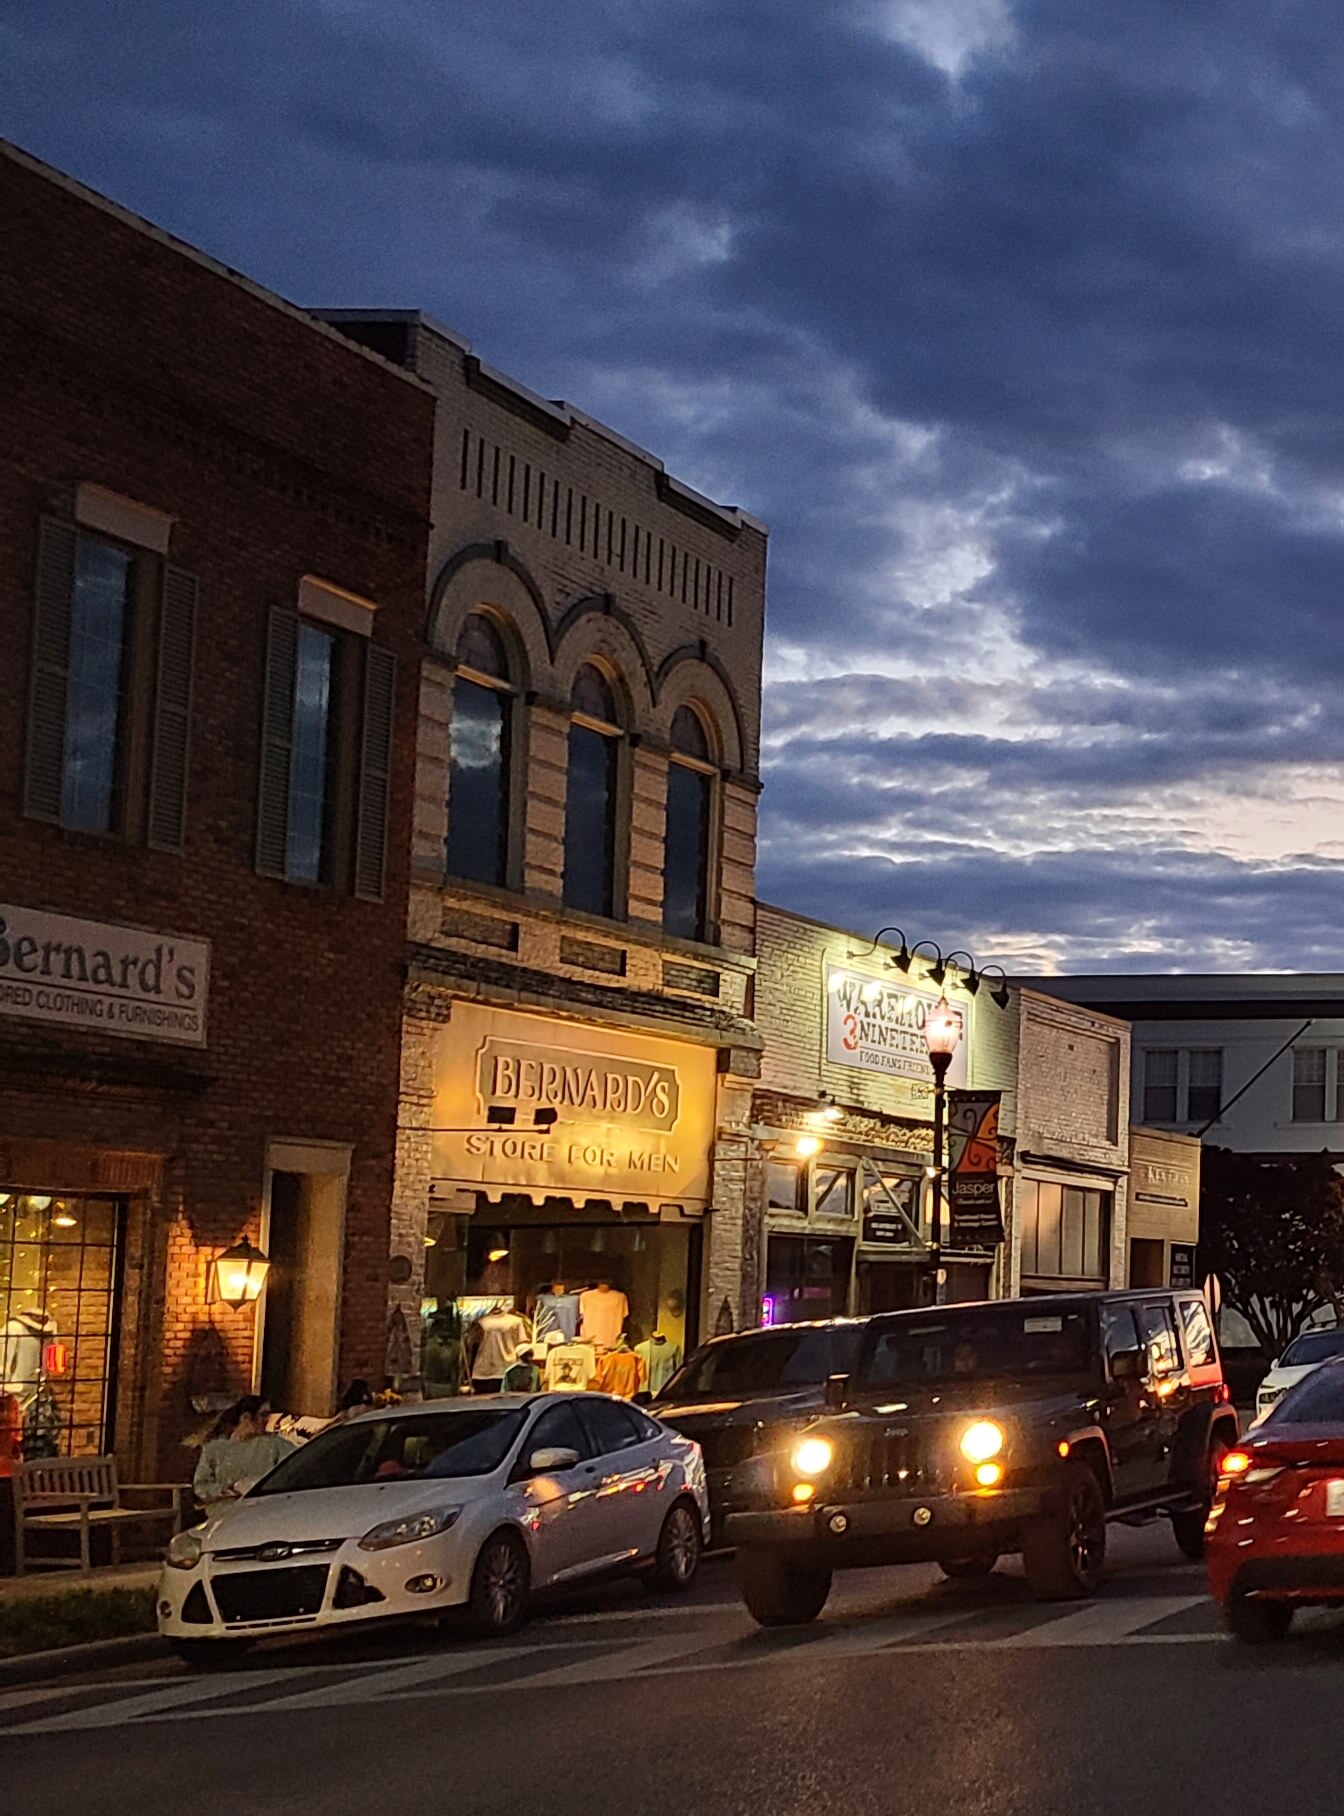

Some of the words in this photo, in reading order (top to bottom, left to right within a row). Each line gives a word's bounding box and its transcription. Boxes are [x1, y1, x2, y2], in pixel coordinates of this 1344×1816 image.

[0, 916, 197, 1001] ernard's
[36, 989, 104, 1018] CLOTHING
[107, 1002, 115, 1020] &
[118, 1003, 200, 1033] FURNISHINGS
[842, 1013, 859, 1051] 3
[859, 1050, 880, 1066] FOOD
[881, 1055, 901, 1070] FANS
[491, 1055, 670, 1119] BERNARD'S
[465, 1134, 557, 1163] STORE
[567, 1144, 616, 1168] FOR
[628, 1150, 680, 1174] MEN
[952, 1181, 995, 1197] Jasper
